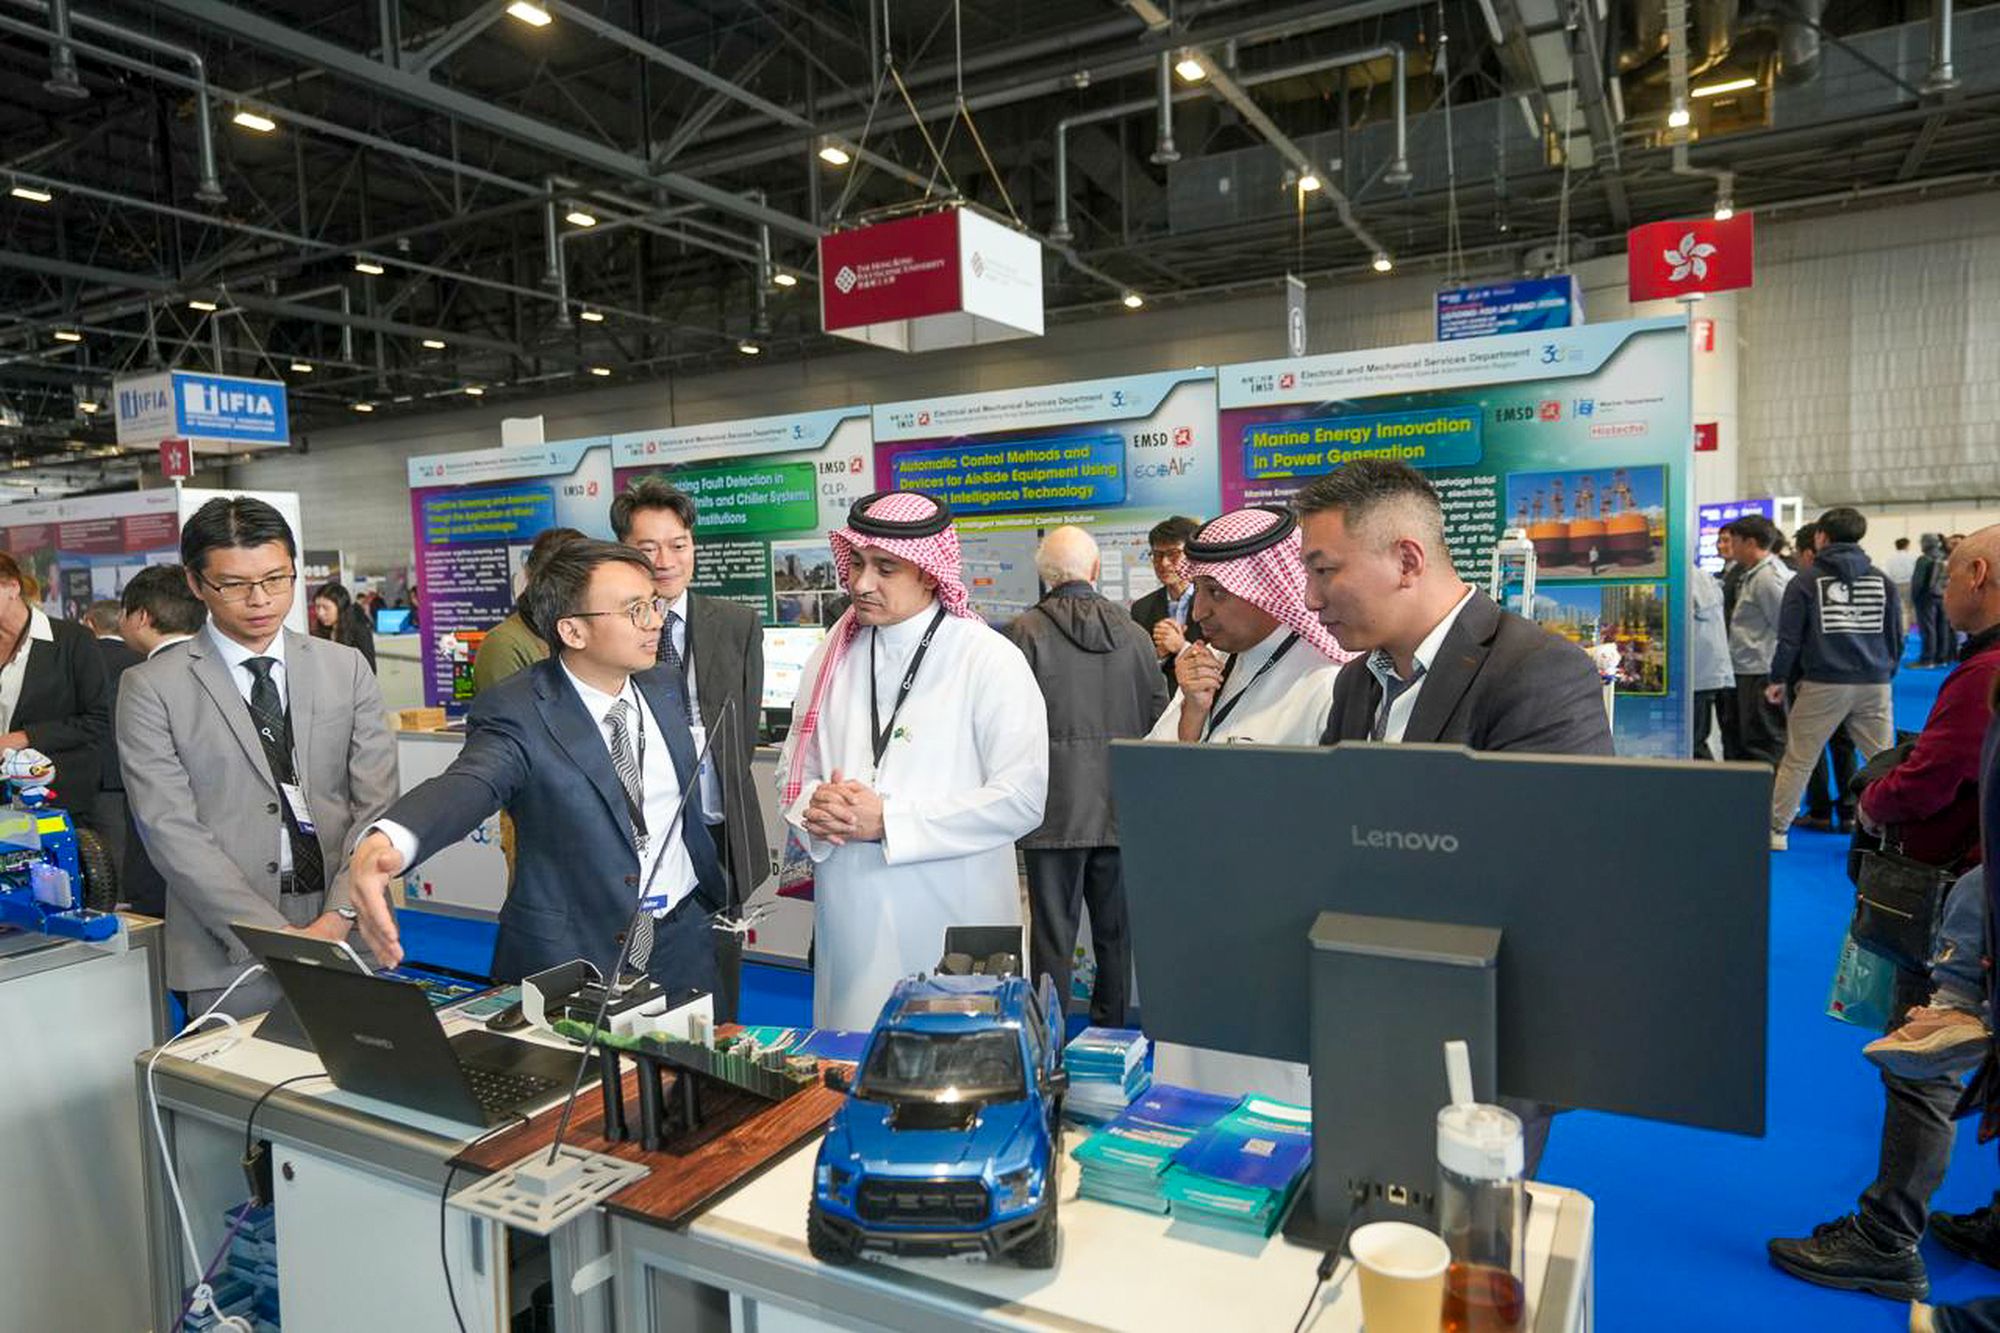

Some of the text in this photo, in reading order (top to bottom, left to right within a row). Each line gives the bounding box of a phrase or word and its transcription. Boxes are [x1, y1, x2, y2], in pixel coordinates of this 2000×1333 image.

[1300, 368, 1344, 380] Electrical
[1346, 364, 1364, 374] and
[1366, 356, 1421, 373] Mechanical
[1424, 355, 1466, 367] Services
[1469, 348, 1530, 363] Department
[220, 390, 275, 415] IFIA
[1496, 406, 1534, 422] EMSD
[1133, 432, 1168, 448] EMSD
[1253, 417, 1472, 449] Marine Energy Innovation
[900, 446, 1090, 473] Automatic Control Methods and
[1273, 450, 1321, 467] Power
[1327, 443, 1426, 463] Generation
[818, 461, 846, 475] EMSD
[899, 476, 944, 490] Devices
[946, 475, 961, 486] for
[1012, 464, 1079, 482] Equipment
[1081, 462, 1118, 479] Using
[701, 475, 725, 491] Fault
[726, 473, 773, 489] Detection
[774, 473, 784, 485] in
[715, 493, 735, 507] and
[736, 491, 769, 505] Chiller
[769, 489, 811, 505] Systems
[949, 488, 1020, 506] Intelligence
[1021, 484, 1095, 501] Technology
[1475, 499, 1497, 508] and
[697, 512, 747, 526] Institutions
[1449, 511, 1470, 521] and
[1351, 824, 1459, 852] Lenovo
